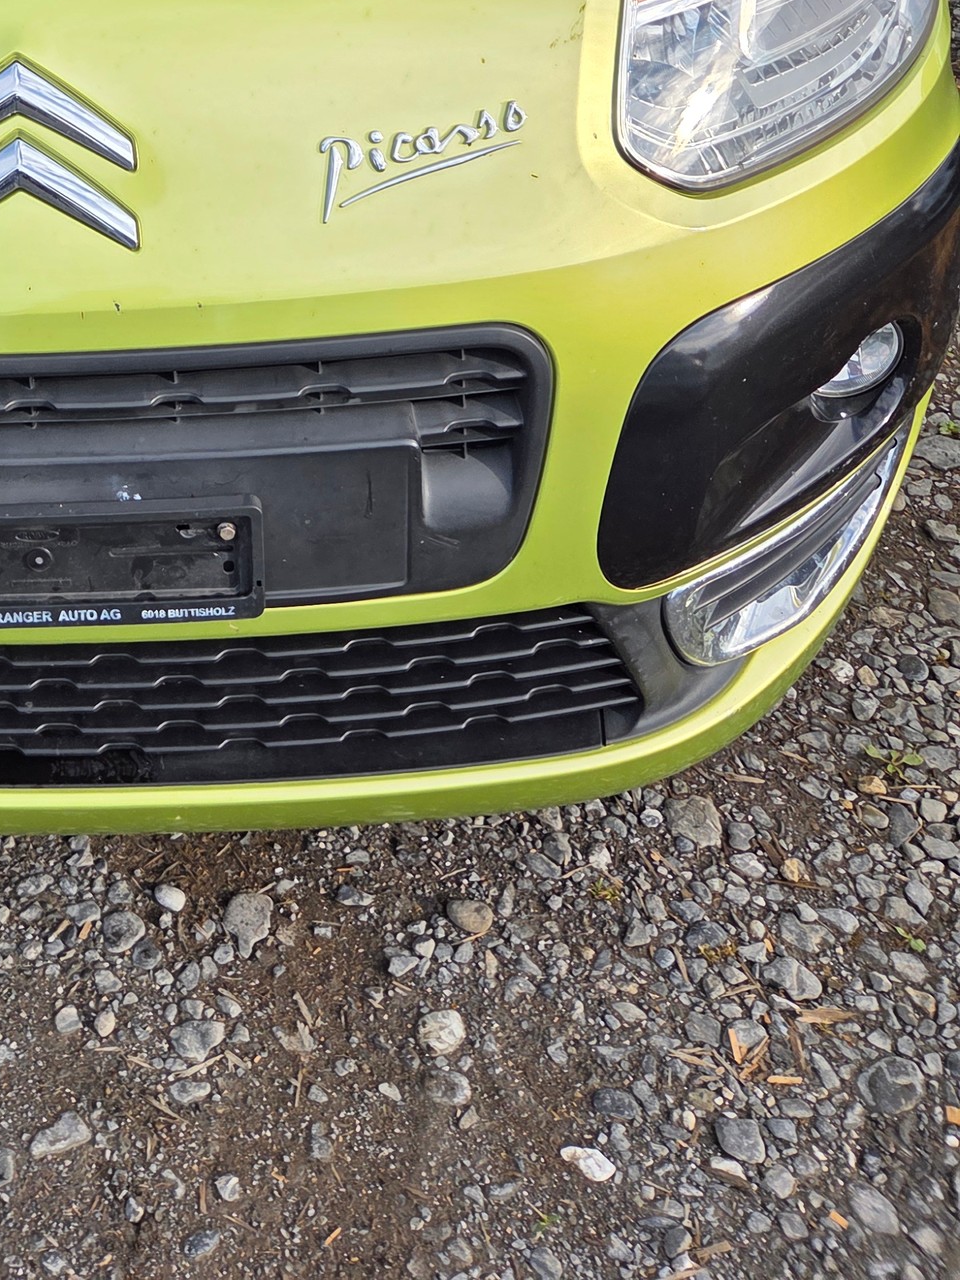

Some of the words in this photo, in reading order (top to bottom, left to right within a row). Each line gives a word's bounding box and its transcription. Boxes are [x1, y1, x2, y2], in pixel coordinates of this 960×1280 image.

[320, 100, 528, 223] Picasso
[58, 609, 98, 622] AUTO
[99, 608, 122, 621] AG
[141, 609, 166, 619] 6018
[167, 606, 236, 618] BUTTISHOLZ
